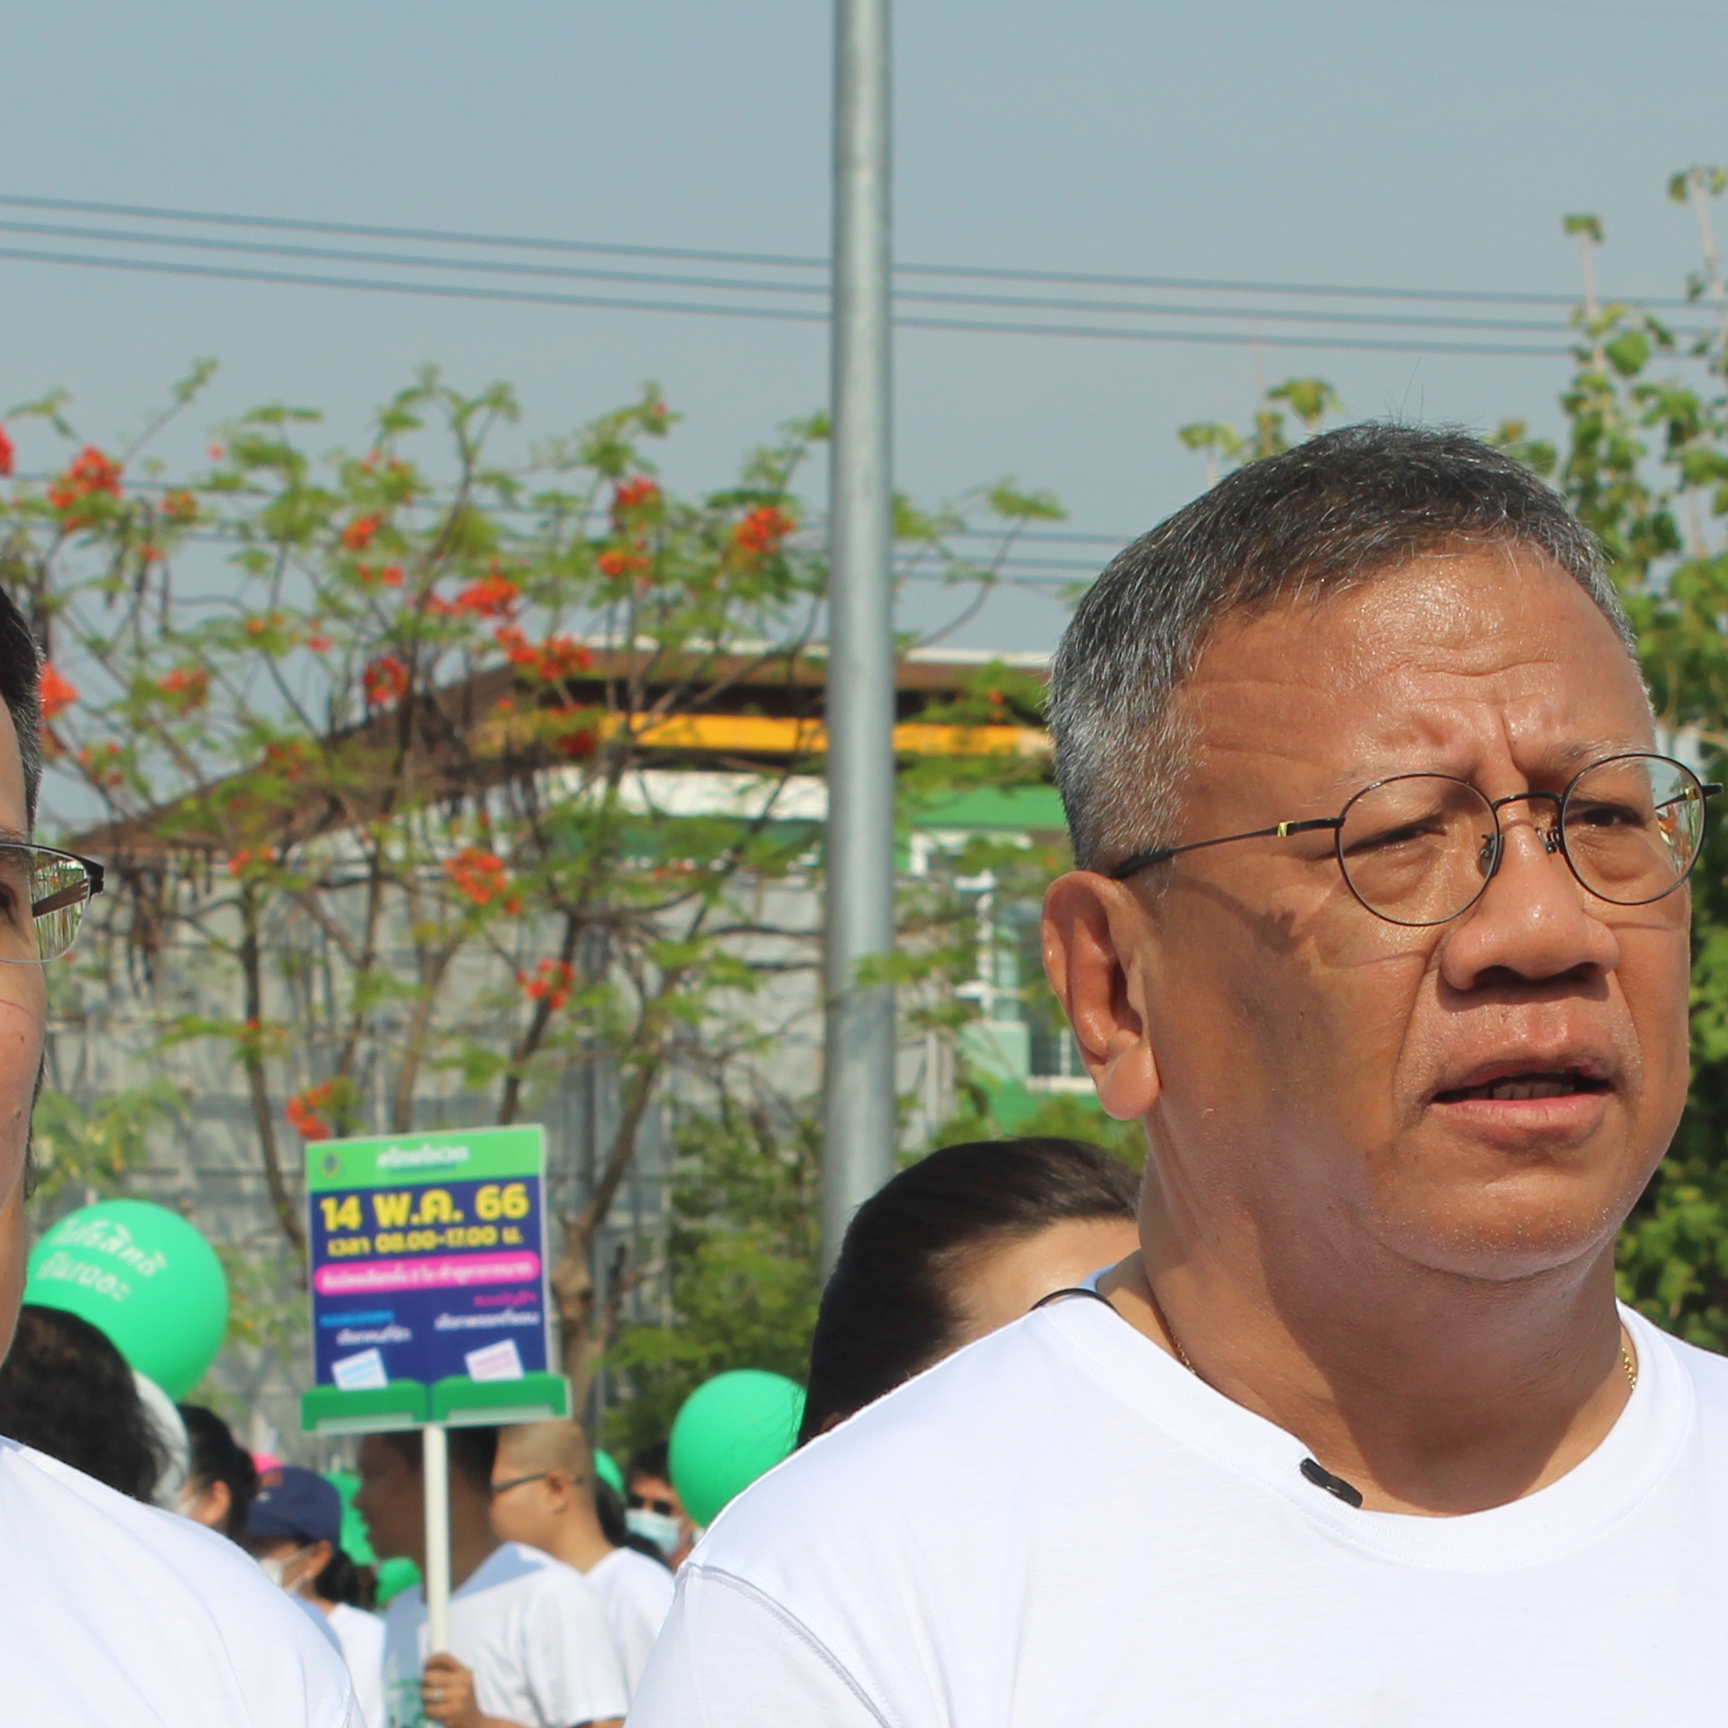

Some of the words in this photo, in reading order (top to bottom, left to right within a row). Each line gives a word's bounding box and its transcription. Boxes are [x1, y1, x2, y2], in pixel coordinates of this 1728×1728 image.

[321, 1196, 362, 1231] 14
[373, 1189, 464, 1227] พ.ค.
[475, 1183, 530, 1220] 66
